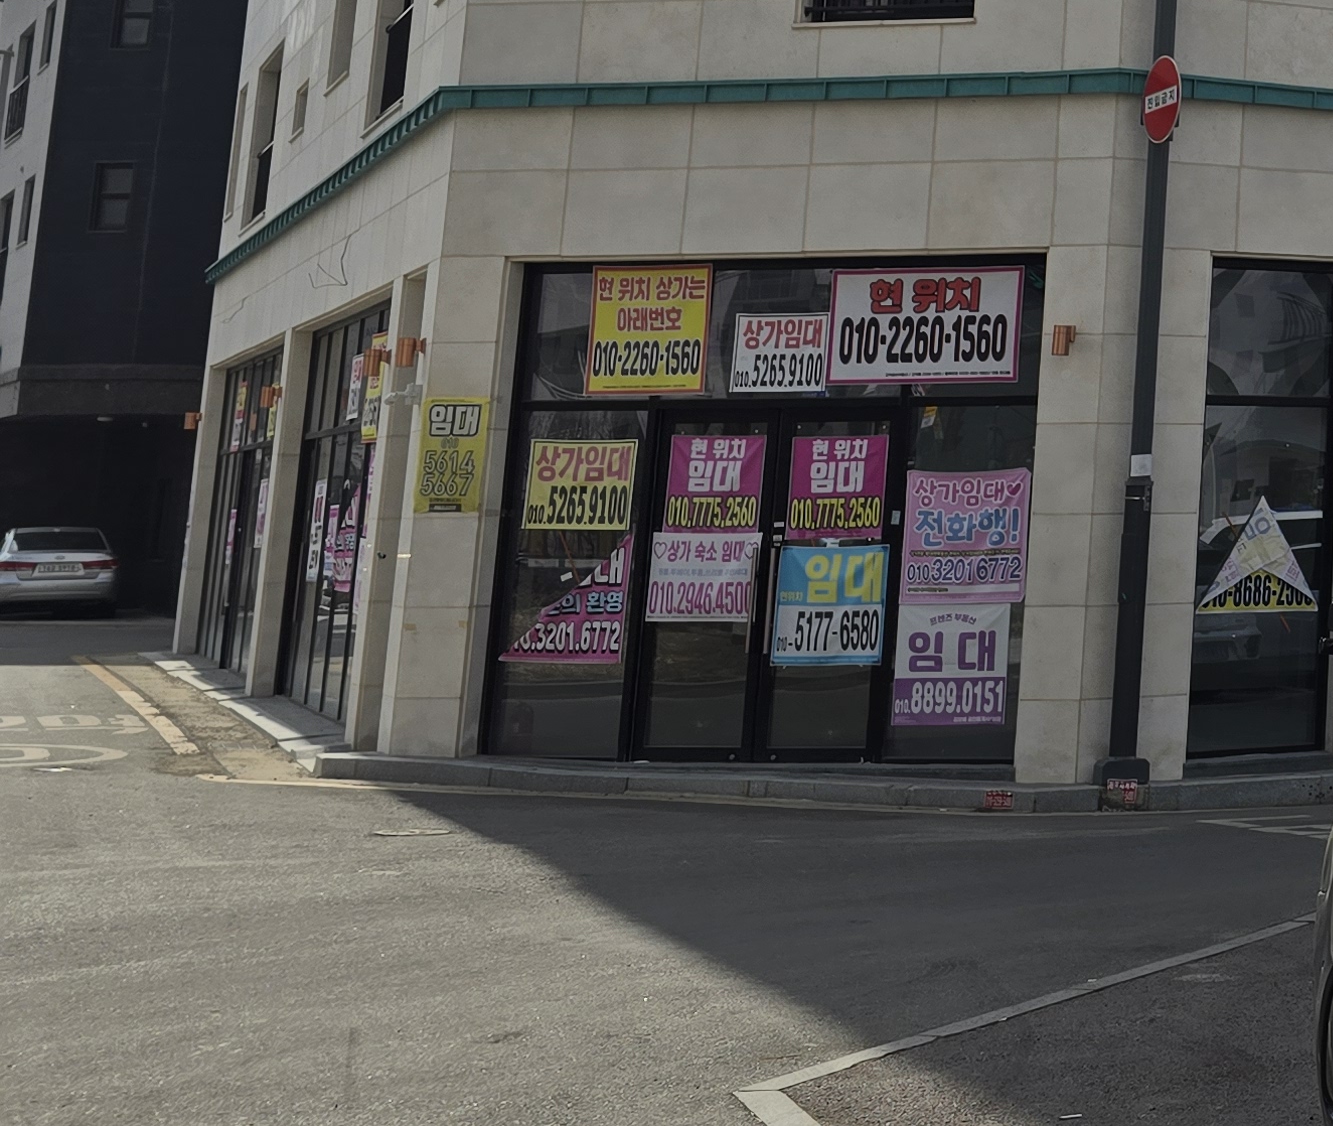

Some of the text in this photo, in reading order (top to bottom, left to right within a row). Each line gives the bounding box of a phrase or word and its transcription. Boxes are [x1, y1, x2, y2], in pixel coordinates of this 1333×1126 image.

[599, 276, 705, 301] 현 위치 상가는
[870, 276, 981, 314] 현 위치
[617, 307, 682, 331] 아래번호
[743, 319, 823, 350] 상가임대
[429, 404, 482, 436] 임대
[441, 438, 459, 449] 010
[690, 439, 746, 459] 현 위치
[812, 439, 868, 459] 현 위치
[424, 450, 475, 474] 5614
[536, 446, 632, 482] 상가임대
[420, 473, 474, 496] 5667
[687, 460, 742, 492] 임대
[810, 461, 865, 493] 임대
[915, 479, 1006, 507] 상가임대
[667, 540, 745, 562] 상가 숙소 임대
[579, 547, 625, 586] 대
[805, 551, 885, 603] 임대
[548, 591, 623, 614] 의 환영
